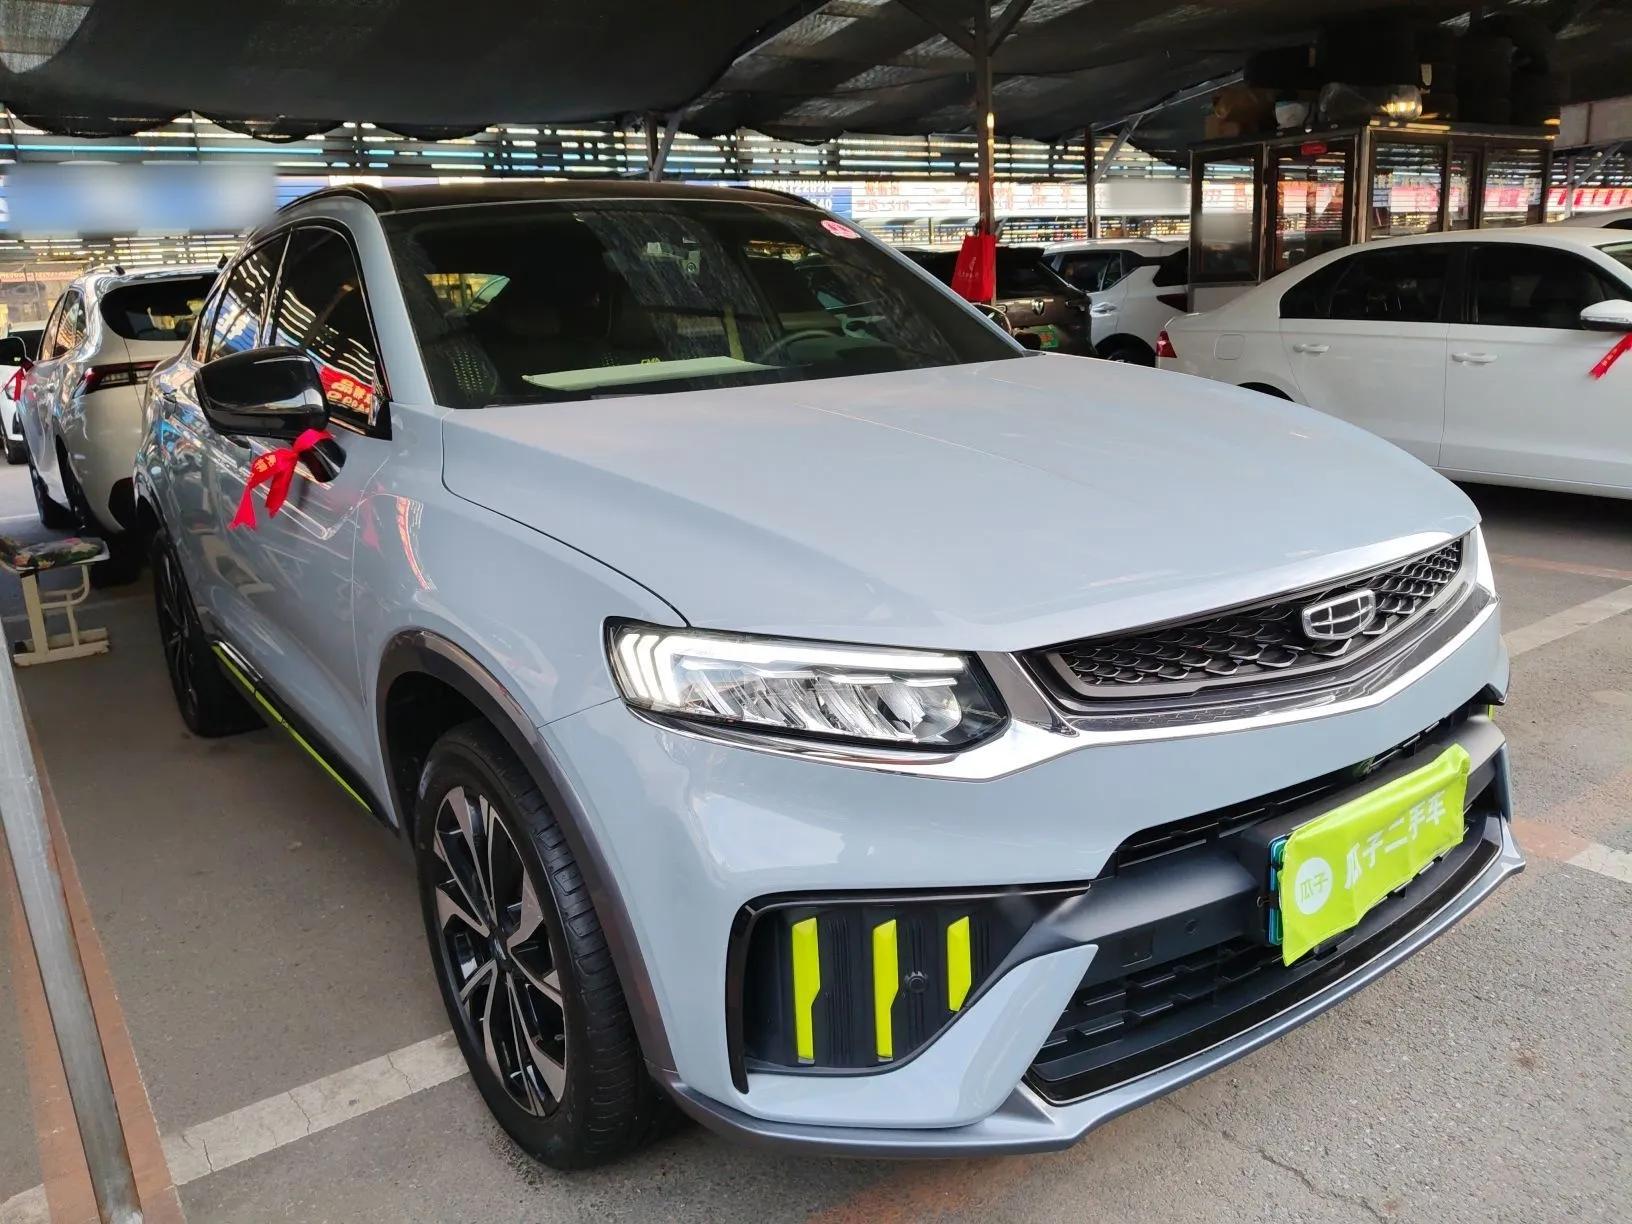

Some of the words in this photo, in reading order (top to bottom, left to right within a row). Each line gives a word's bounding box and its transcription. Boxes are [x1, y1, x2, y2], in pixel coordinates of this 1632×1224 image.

[1344, 790, 1446, 890] 瓜子二手车
[1300, 871, 1329, 904] 瓜子
